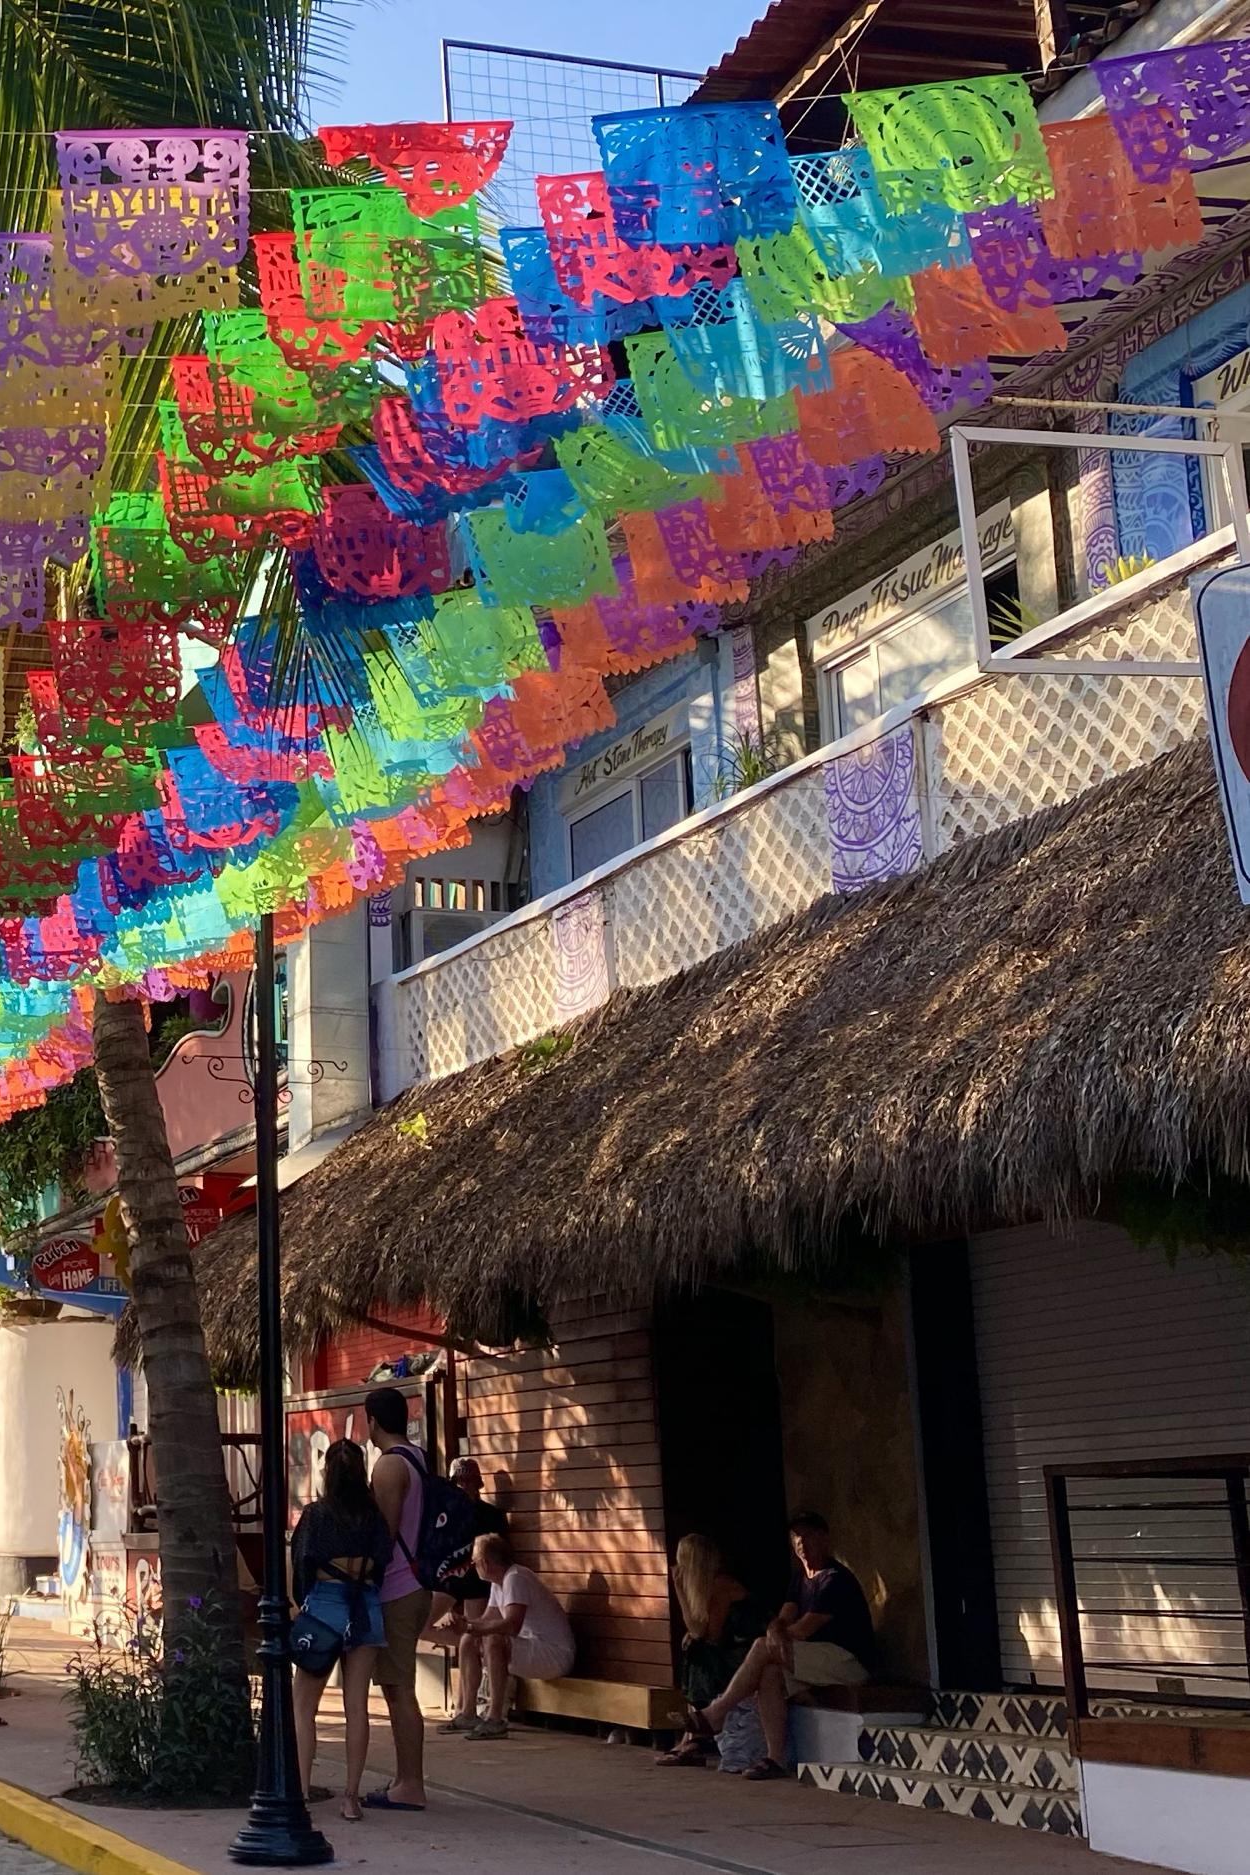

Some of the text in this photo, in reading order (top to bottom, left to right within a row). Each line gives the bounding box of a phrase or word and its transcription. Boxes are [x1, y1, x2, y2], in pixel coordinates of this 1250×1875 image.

[70, 186, 238, 219] SAYULITA
[822, 513, 1015, 647] Deep Tissue Maage
[631, 725, 669, 759] Therapy
[33, 1238, 80, 1270] Ruben
[61, 1268, 95, 1290] HOME
